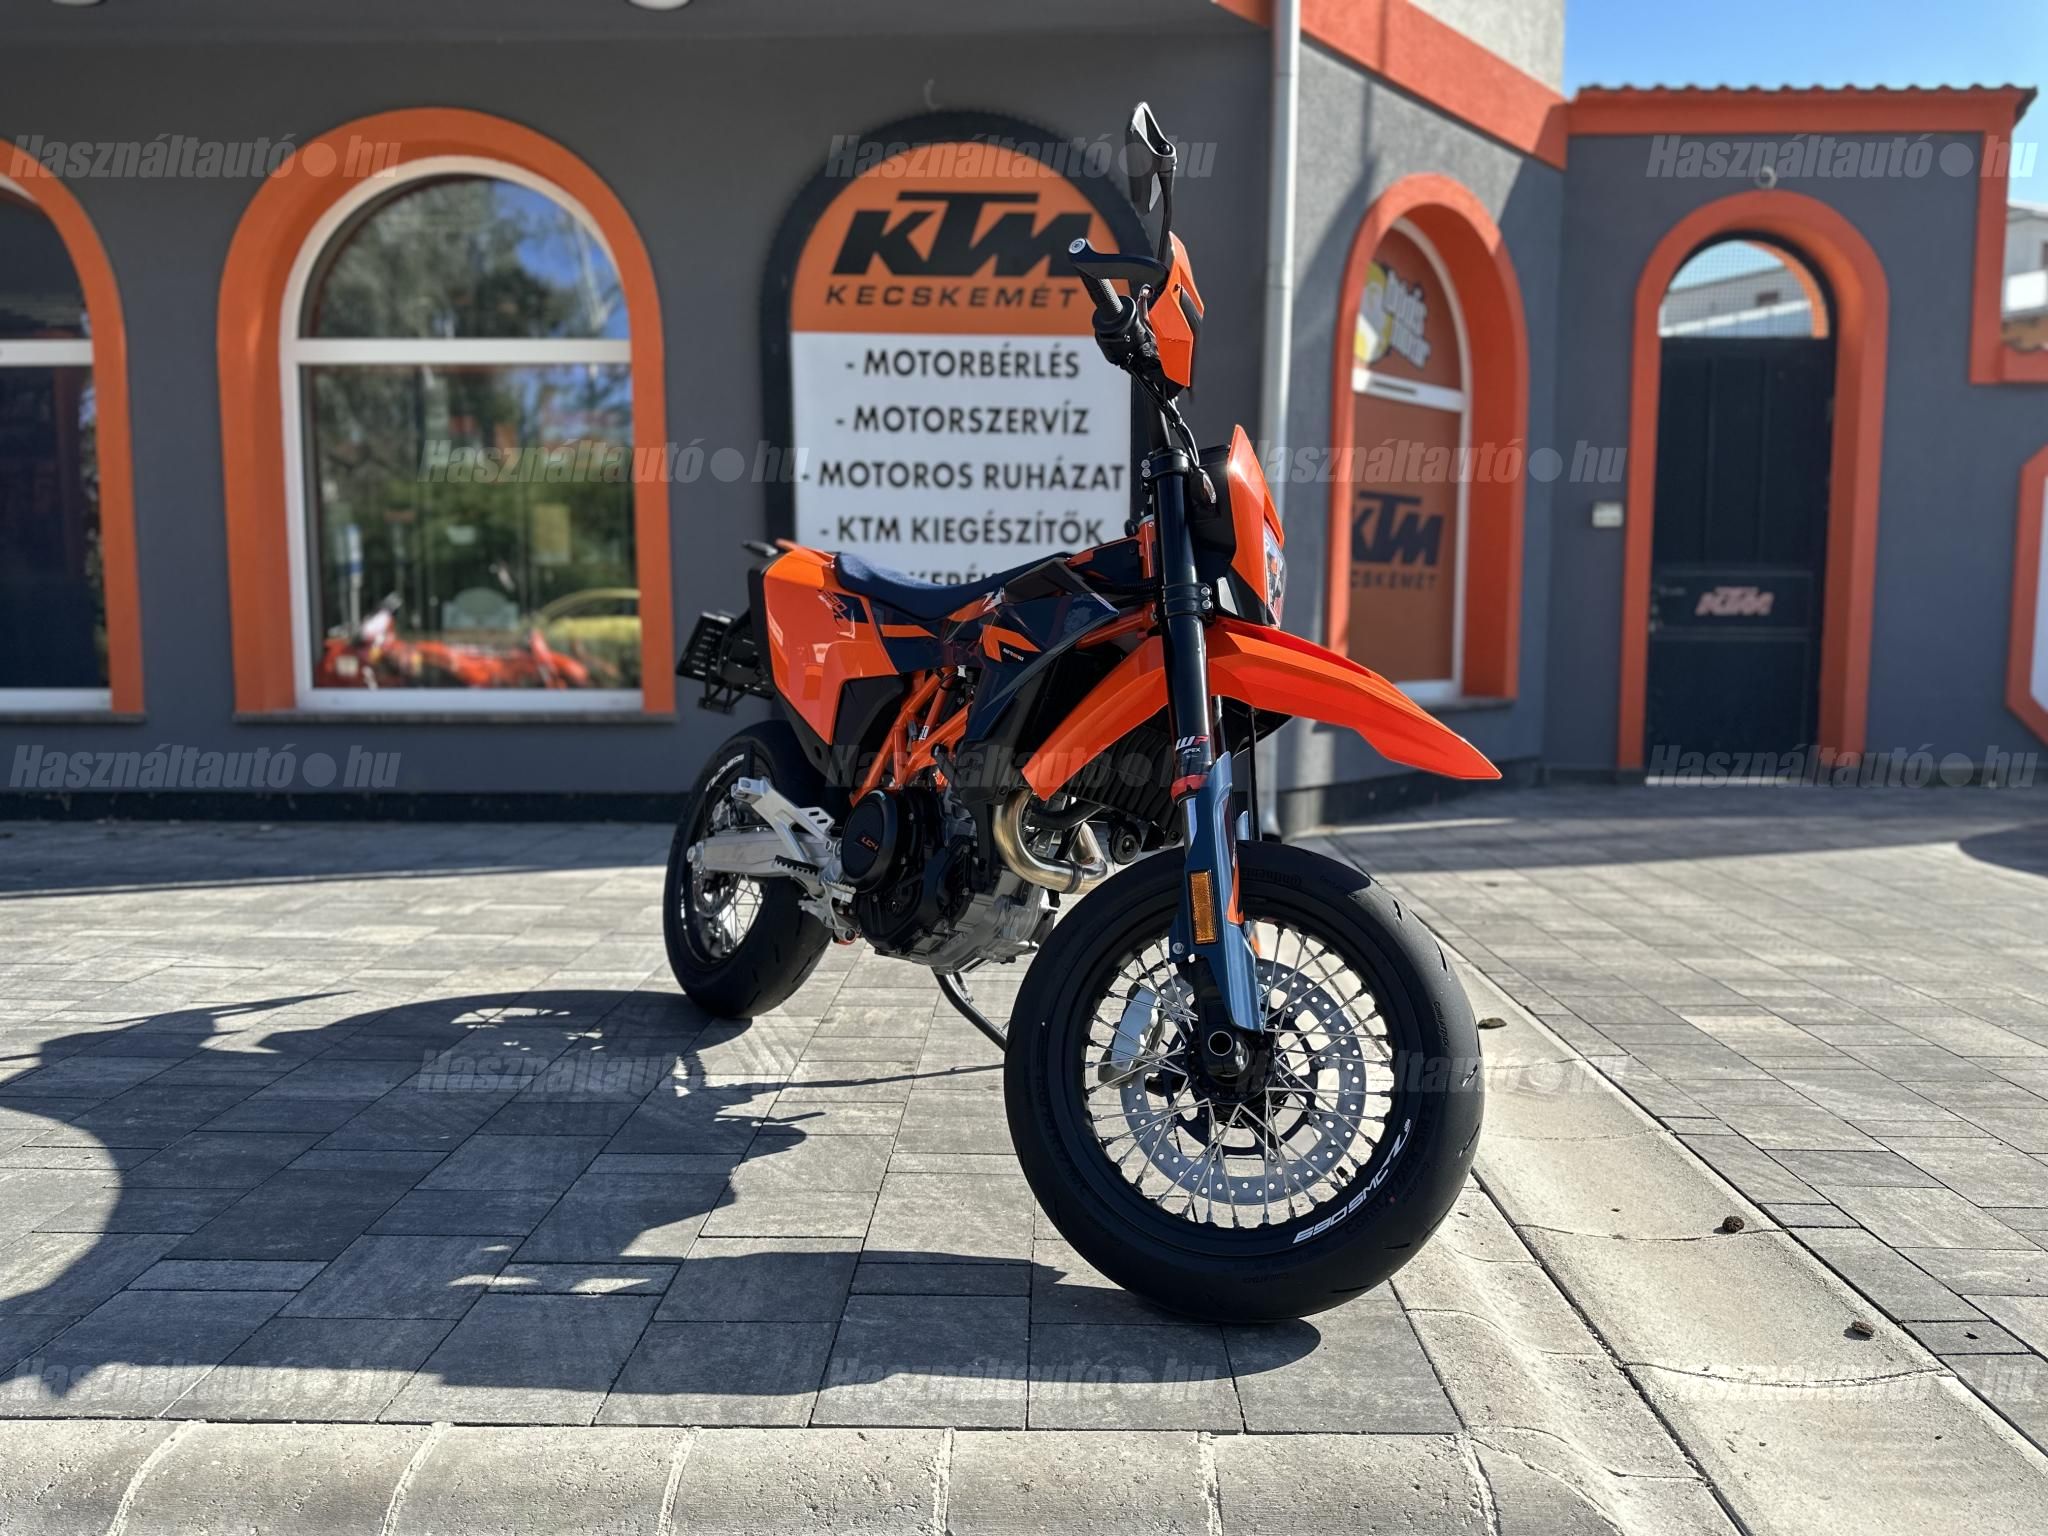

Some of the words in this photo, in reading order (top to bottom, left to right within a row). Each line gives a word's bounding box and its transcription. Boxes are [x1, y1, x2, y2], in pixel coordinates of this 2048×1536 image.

[832, 191, 1093, 277] KTM
[826, 281, 1078, 309] KECSKEMÉT
[864, 342, 1079, 378] MOTORBÉRLÉS
[854, 400, 1089, 434] MOTORSZERVÍZ
[819, 461, 973, 489] MOTOROS
[983, 456, 1125, 490] RUHÁZAT
[838, 517, 900, 542] KTM
[911, 511, 1104, 546] KIEGÉSZÍTŐK
[1175, 735, 1208, 751] WP
